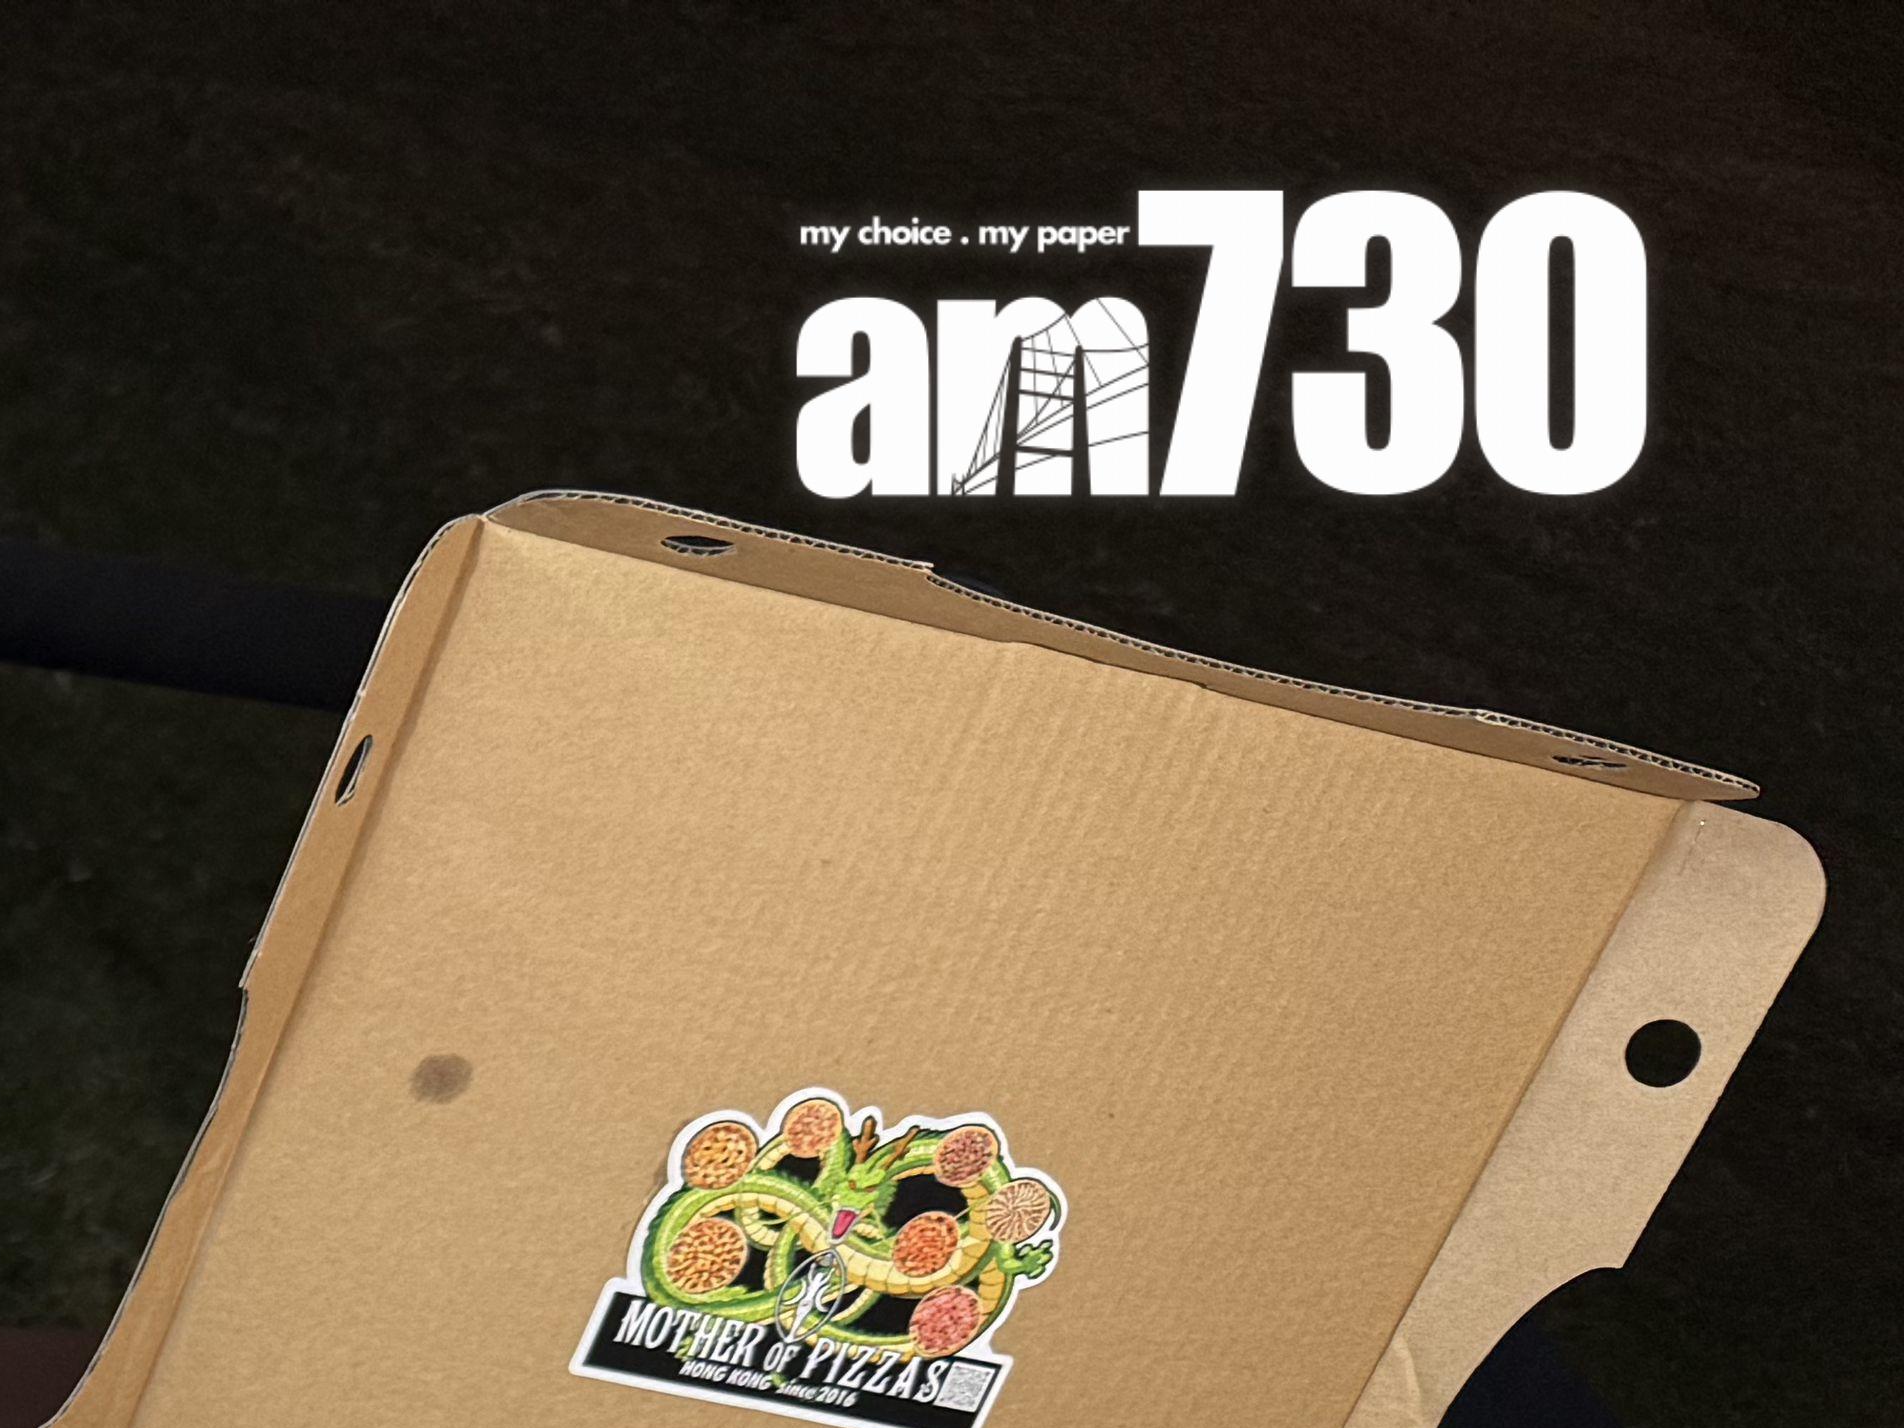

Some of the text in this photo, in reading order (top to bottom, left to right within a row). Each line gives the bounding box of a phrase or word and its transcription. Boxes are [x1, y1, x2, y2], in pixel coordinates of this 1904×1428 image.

[613, 1299, 768, 1367] MOTHER
[801, 1337, 952, 1404] PIZZAS
[679, 1360, 728, 1382] HONG
[725, 1368, 772, 1391] KONG
[816, 1388, 861, 1408] 2016
